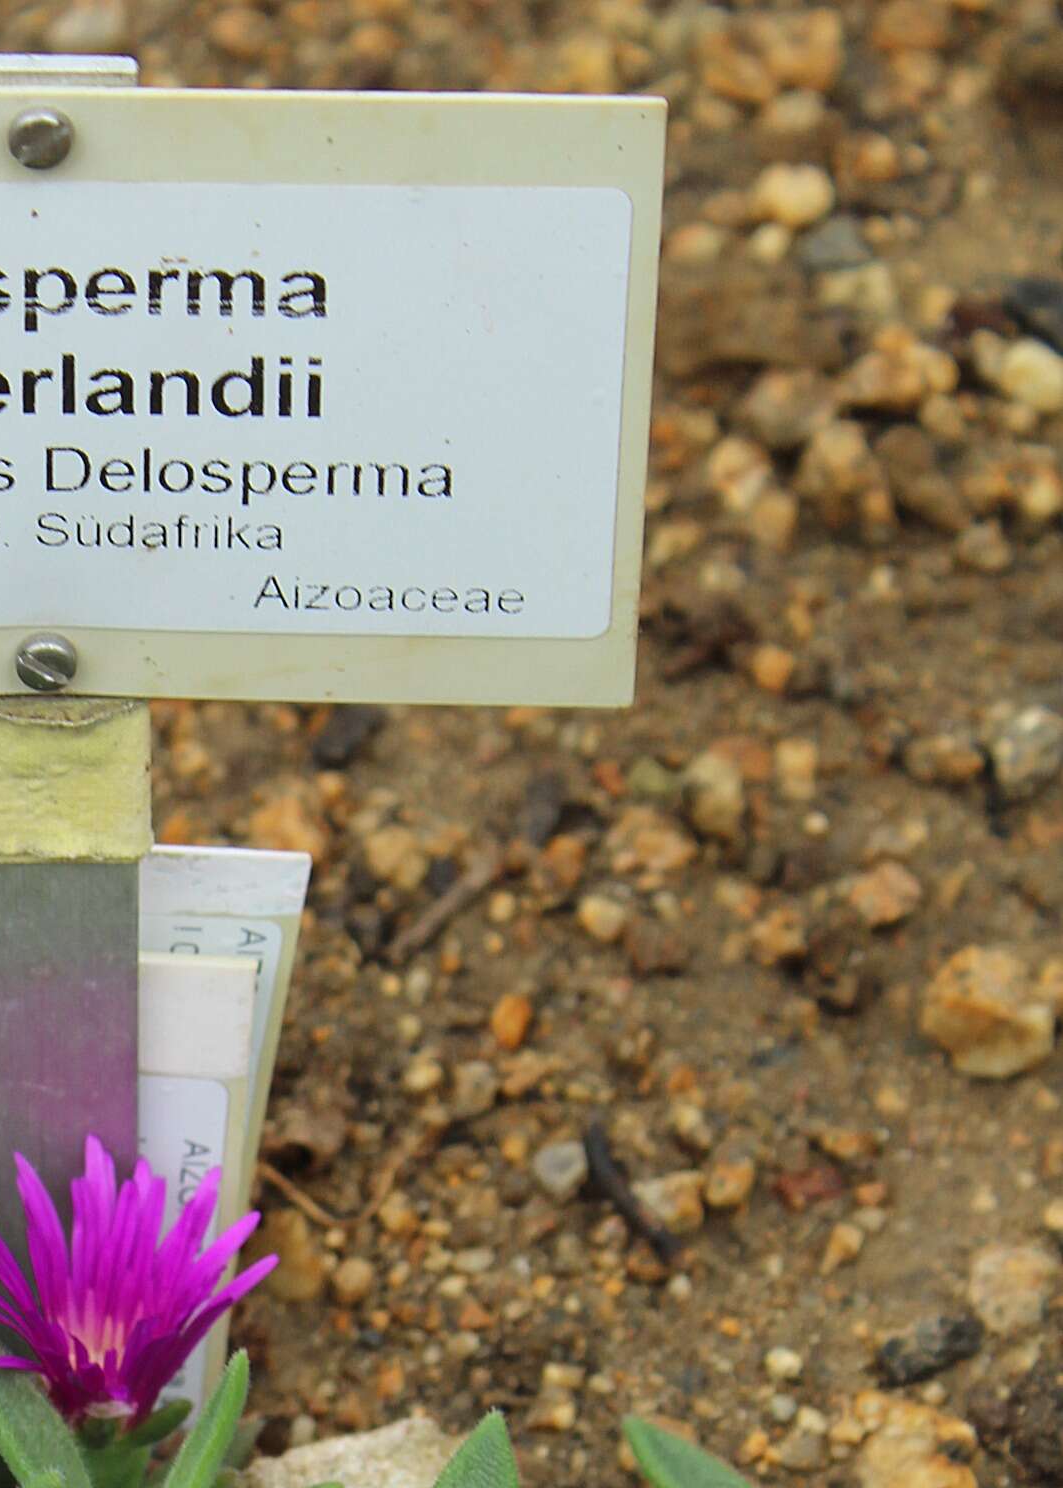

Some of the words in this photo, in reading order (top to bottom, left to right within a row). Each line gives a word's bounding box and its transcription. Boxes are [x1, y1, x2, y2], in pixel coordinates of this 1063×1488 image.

[45, 446, 453, 508] Delosperma
[34, 511, 284, 553] Südafrika
[253, 574, 525, 615] Aizoaceae
